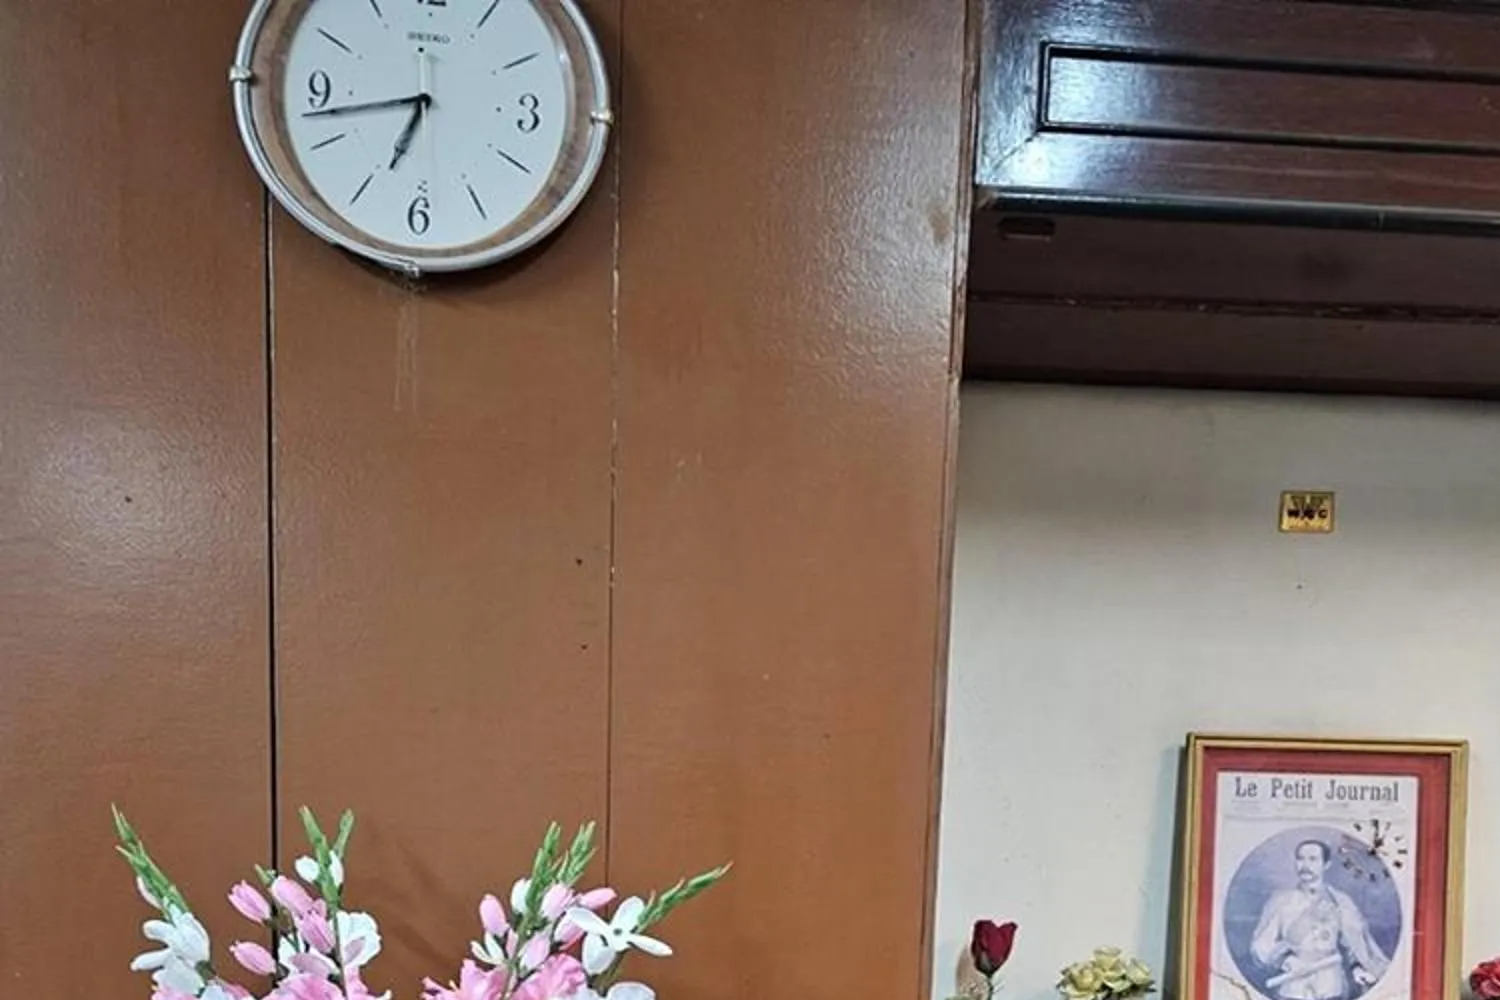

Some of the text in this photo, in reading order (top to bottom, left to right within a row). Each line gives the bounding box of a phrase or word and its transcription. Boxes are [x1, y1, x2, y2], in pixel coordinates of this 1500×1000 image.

[308, 71, 331, 108] 9
[517, 94, 540, 133] 3
[408, 195, 430, 235] 6
[1234, 776, 1399, 802] Le Petit Journal
